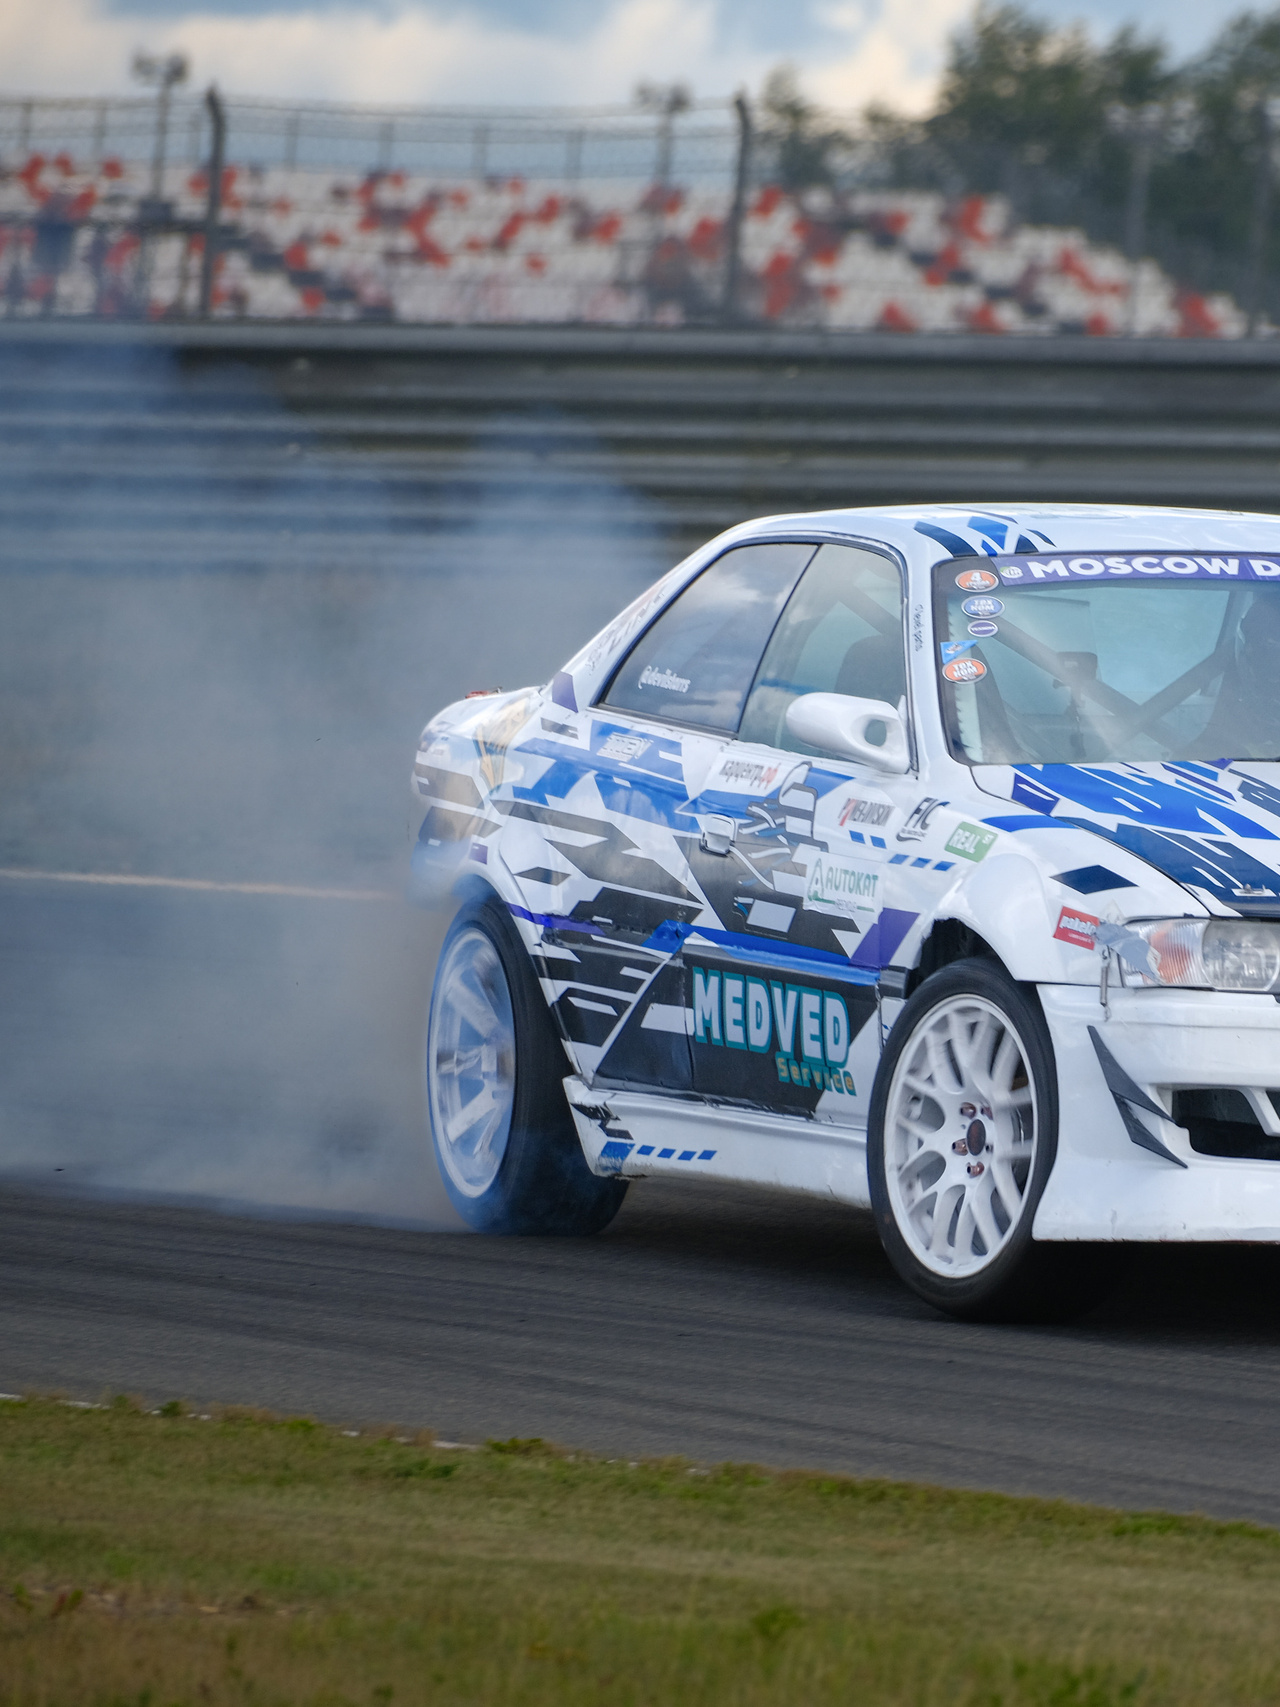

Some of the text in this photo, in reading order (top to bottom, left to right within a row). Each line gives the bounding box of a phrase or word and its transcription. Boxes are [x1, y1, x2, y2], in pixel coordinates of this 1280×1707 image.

[1026, 556, 1240, 578] MOSCOW
[948, 828, 982, 854] REAL
[825, 866, 879, 897] AUTOKAT
[692, 966, 850, 1069] MEDVED
[775, 1054, 857, 1096] Service
